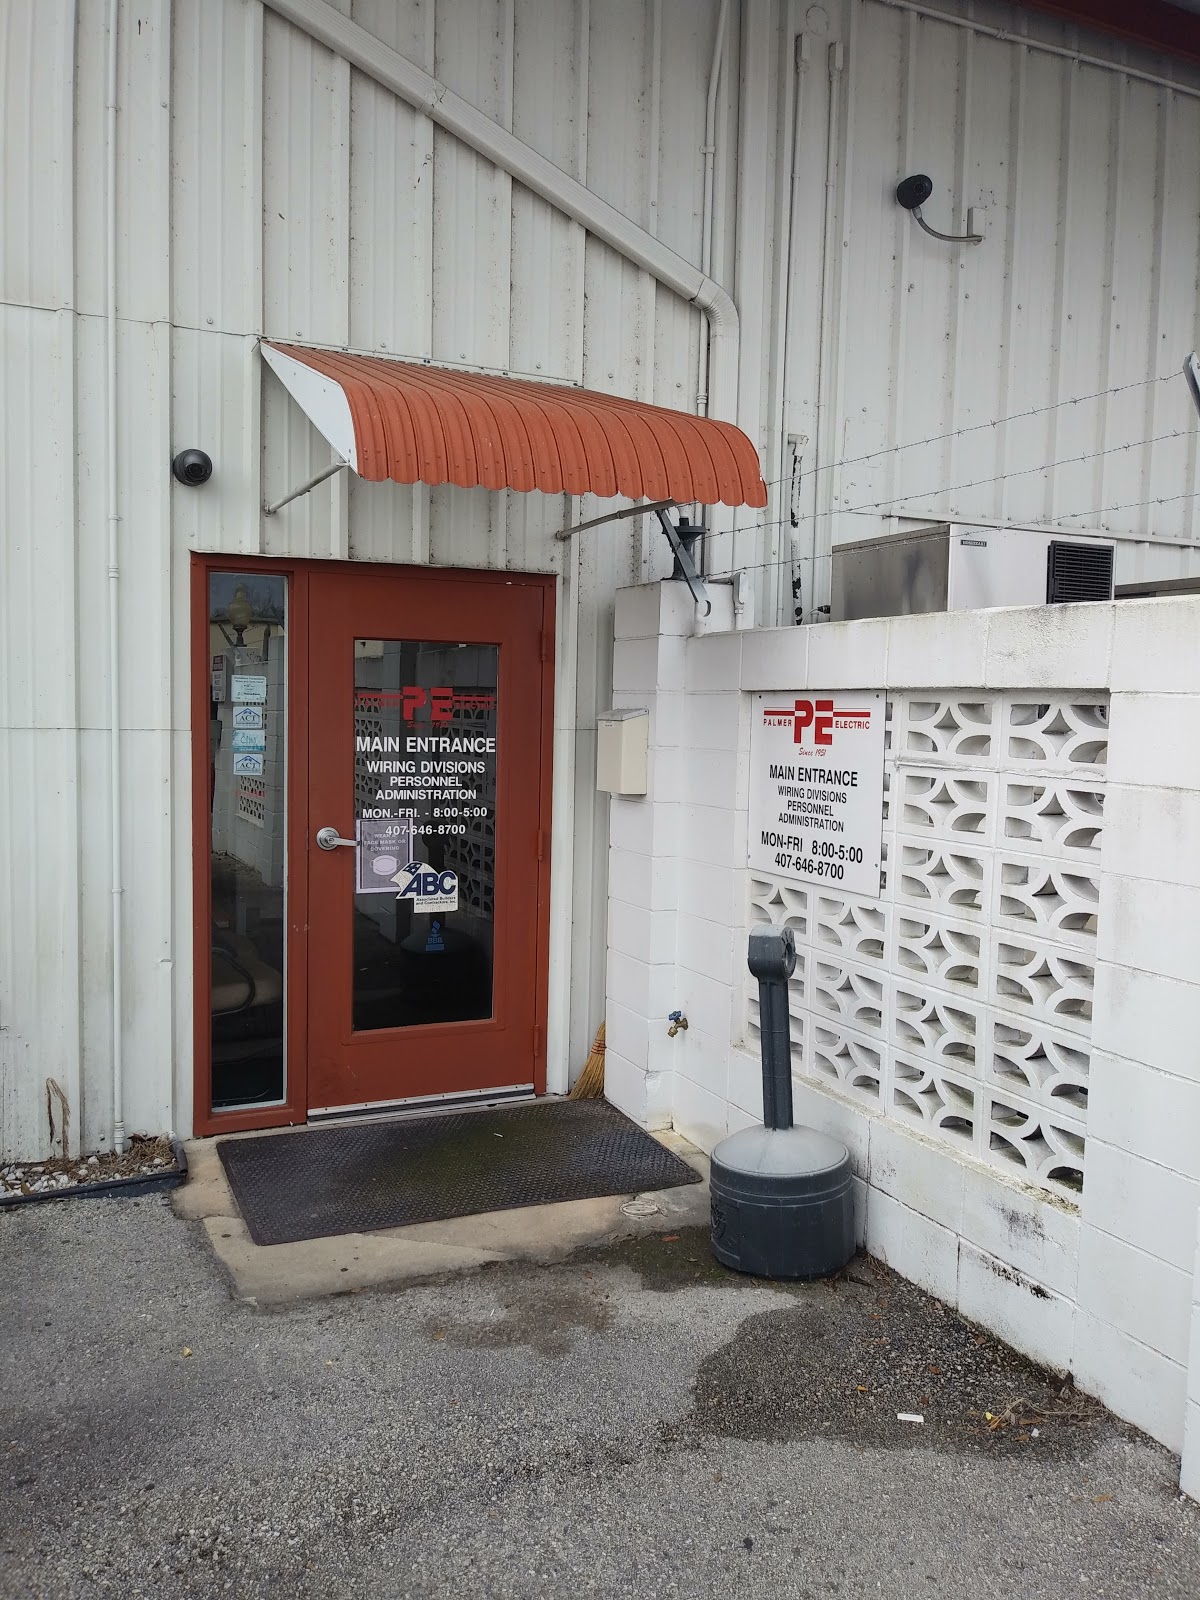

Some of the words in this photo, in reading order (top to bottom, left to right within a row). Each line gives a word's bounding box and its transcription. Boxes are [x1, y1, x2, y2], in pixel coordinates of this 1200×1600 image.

[402, 687, 453, 720] PE
[763, 718, 792, 727] PALMER
[835, 720, 870, 730] ELECTRIC
[793, 699, 834, 745] PE
[356, 736, 399, 752] MAIN
[406, 737, 496, 753] ENTRANCE
[798, 747, 813, 757] Since
[366, 761, 416, 773] WIRING
[420, 761, 485, 773] DIVISIONS
[769, 764, 795, 781] MAIN
[797, 766, 858, 787] ENTRANCE
[390, 776, 462, 787] PERSONNEL
[375, 789, 477, 800] ADMINISTRATION
[777, 785, 805, 799] WIRING
[806, 788, 847, 804] DIVISIONS
[362, 808, 421, 818] MON.-FRI.
[433, 807, 488, 818] 8:00-5:00
[787, 800, 834, 817] PERSONNEL
[385, 824, 466, 836] 407-646-8700
[778, 812, 844, 833] ADMINISTRATION
[761, 830, 803, 852] MON-FRI
[811, 840, 863, 863] 8:00-5:00
[774, 852, 844, 880] 407-646-8700
[399, 871, 456, 897] ABC
